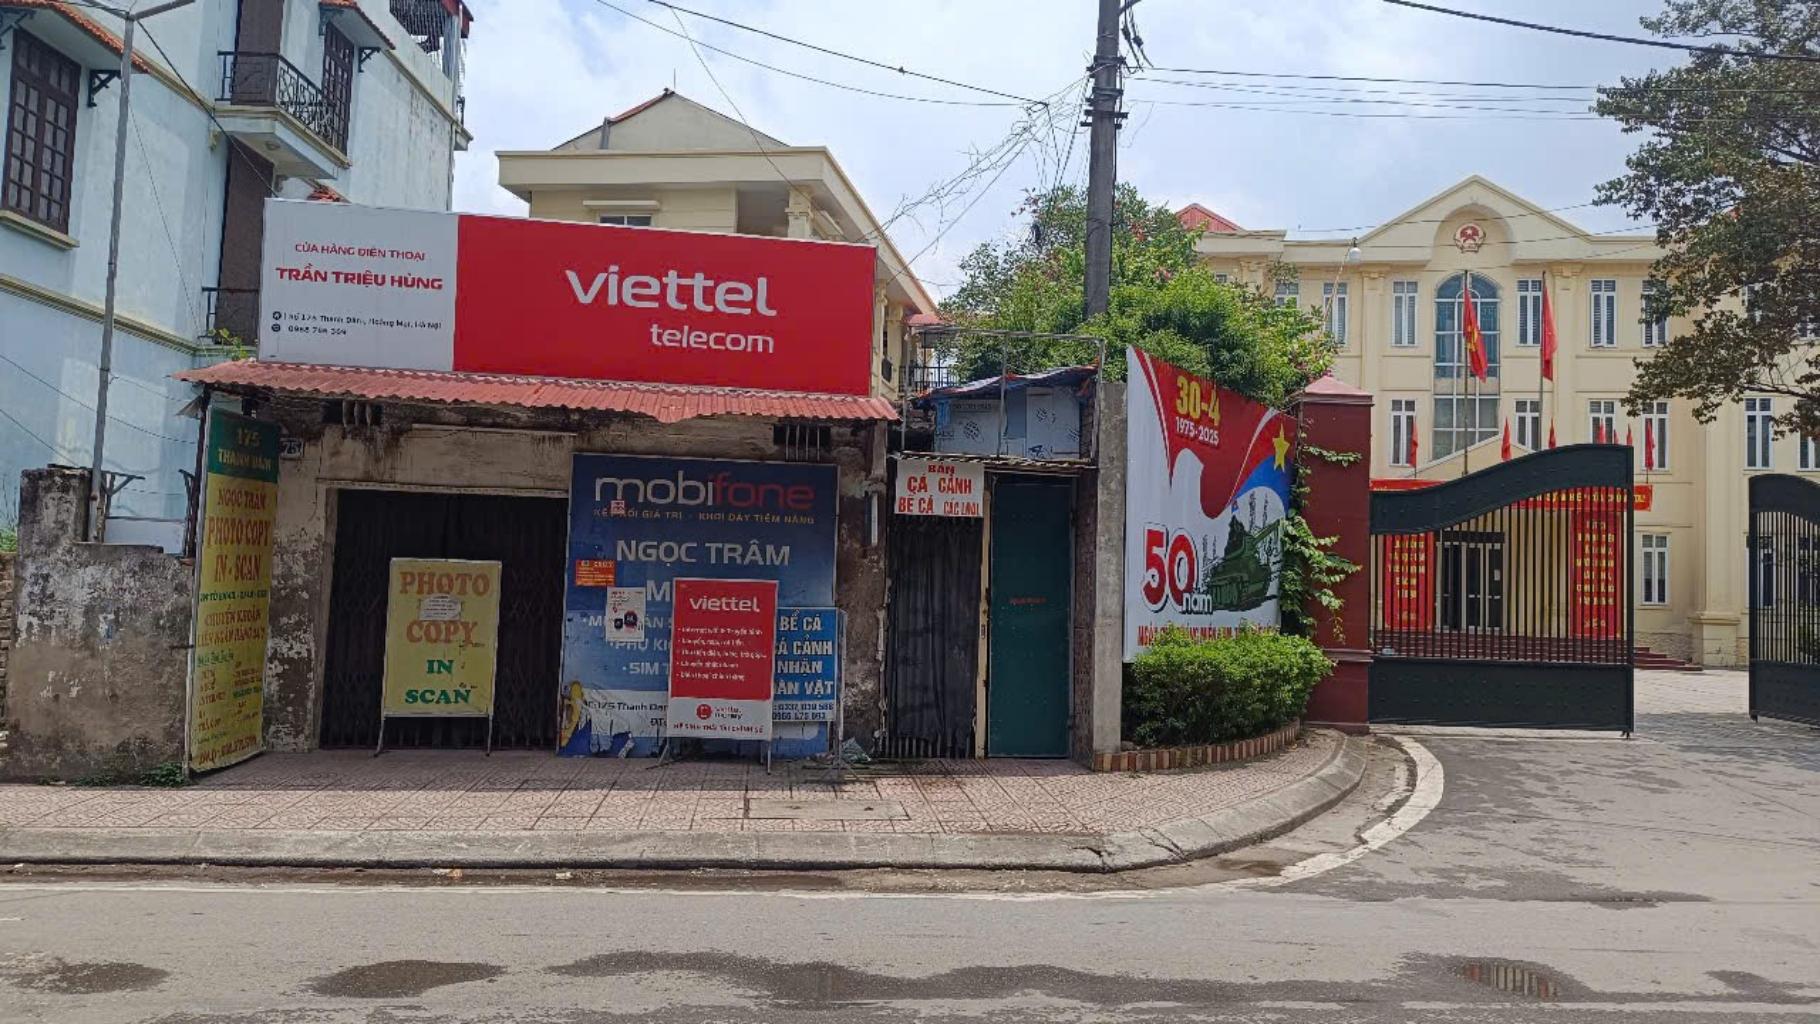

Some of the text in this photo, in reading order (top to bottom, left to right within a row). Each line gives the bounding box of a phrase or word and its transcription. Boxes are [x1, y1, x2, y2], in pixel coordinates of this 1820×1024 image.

[321, 243, 355, 257] HÀNG
[388, 249, 425, 262] THOẠI
[275, 263, 443, 290] TRẦN TRIỆU HÙNG
[564, 265, 778, 317] viettel
[650, 323, 775, 354] telecom
[1175, 375, 1221, 427] 30-4
[237, 427, 261, 447] 175
[595, 470, 816, 509] mobifone
[918, 494, 934, 514] CÁ
[208, 516, 271, 547] PHOTO COPY
[616, 538, 791, 567] NGỌC TRÂM
[215, 554, 228, 582] IN
[234, 553, 262, 582] SCAN
[1142, 526, 1199, 610] 50
[399, 571, 490, 596] PHOTO
[689, 596, 761, 613] viettel
[1182, 589, 1214, 615] năm
[406, 619, 478, 645] COPY
[803, 613, 822, 631] CÁ
[793, 634, 833, 655] CẢNH
[426, 659, 454, 675] IN
[629, 662, 660, 675] SIM
[405, 689, 472, 705] SCAN
[617, 702, 648, 711] Thanh
